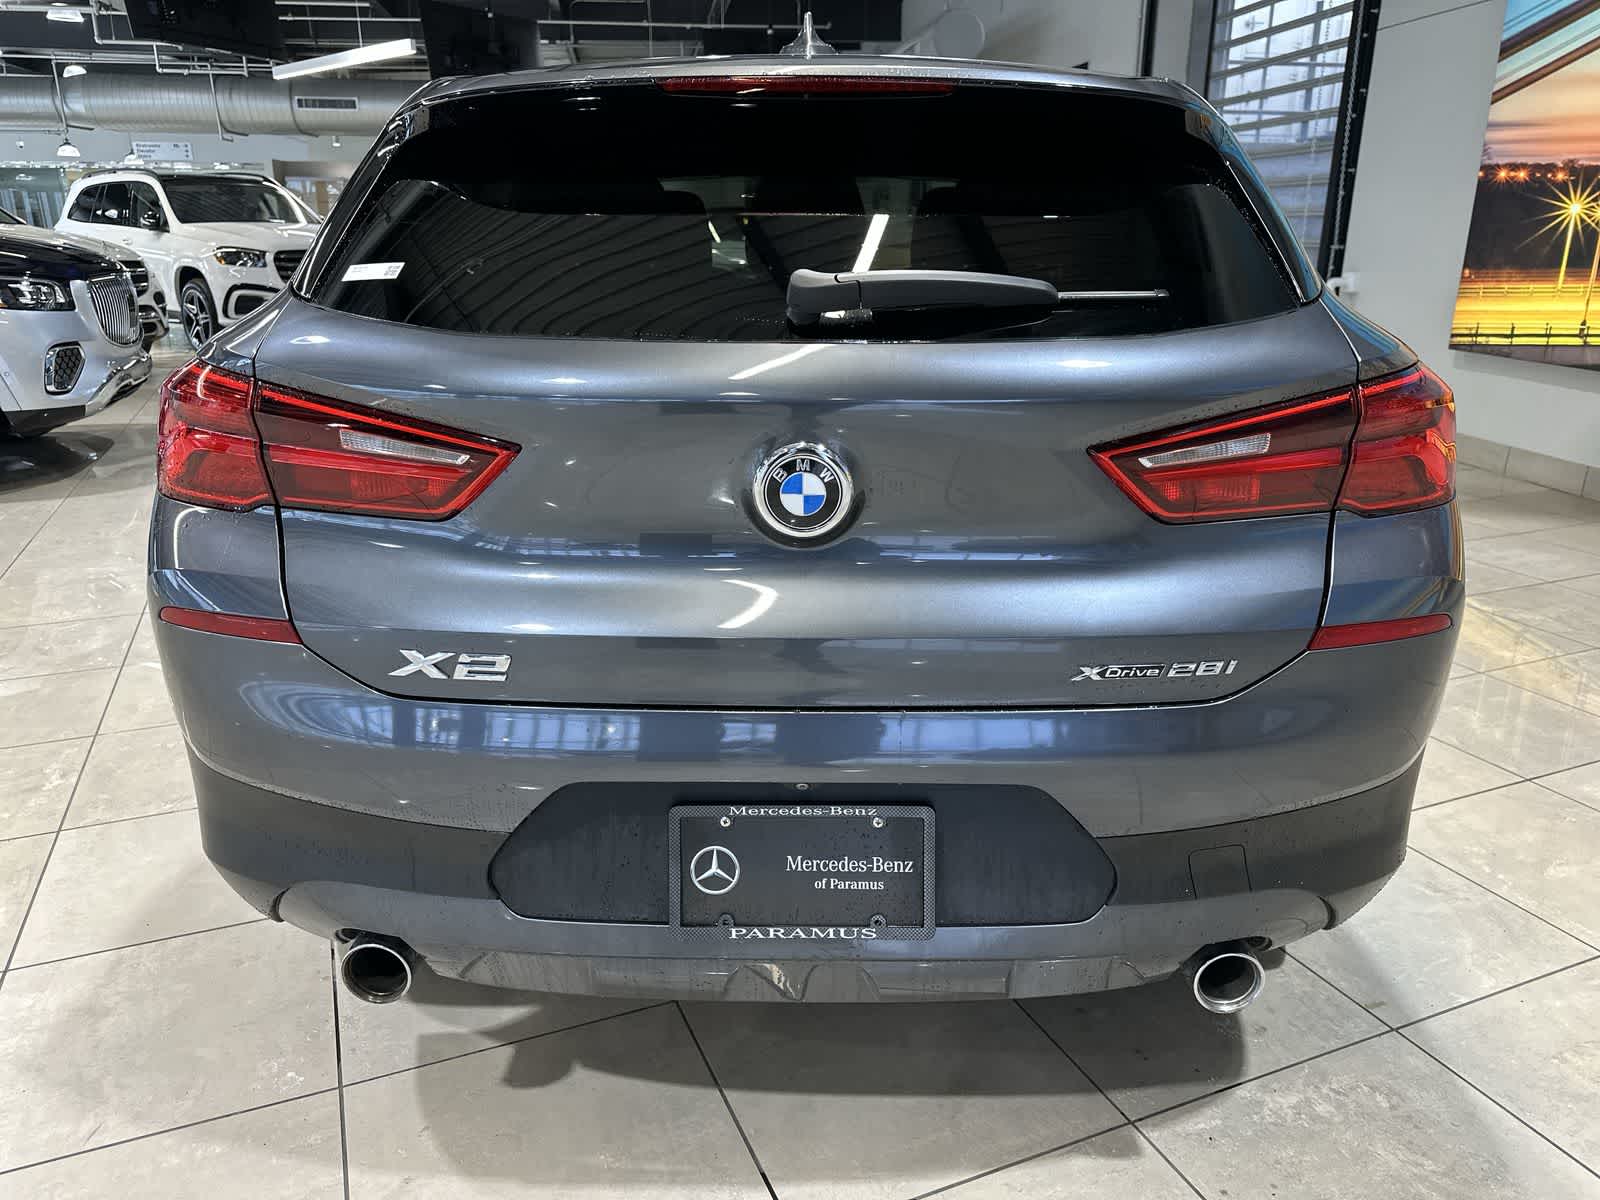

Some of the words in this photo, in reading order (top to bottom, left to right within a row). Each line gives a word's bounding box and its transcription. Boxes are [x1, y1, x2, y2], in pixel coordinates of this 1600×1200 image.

[772, 459, 835, 483] BMW
[387, 649, 512, 682] X2
[729, 806, 878, 817] Mercedes-Benz
[786, 855, 914, 873] Mercedes-Benz
[814, 878, 827, 890] of
[829, 878, 885, 891] Paramus
[728, 927, 878, 939] PARAMUS
